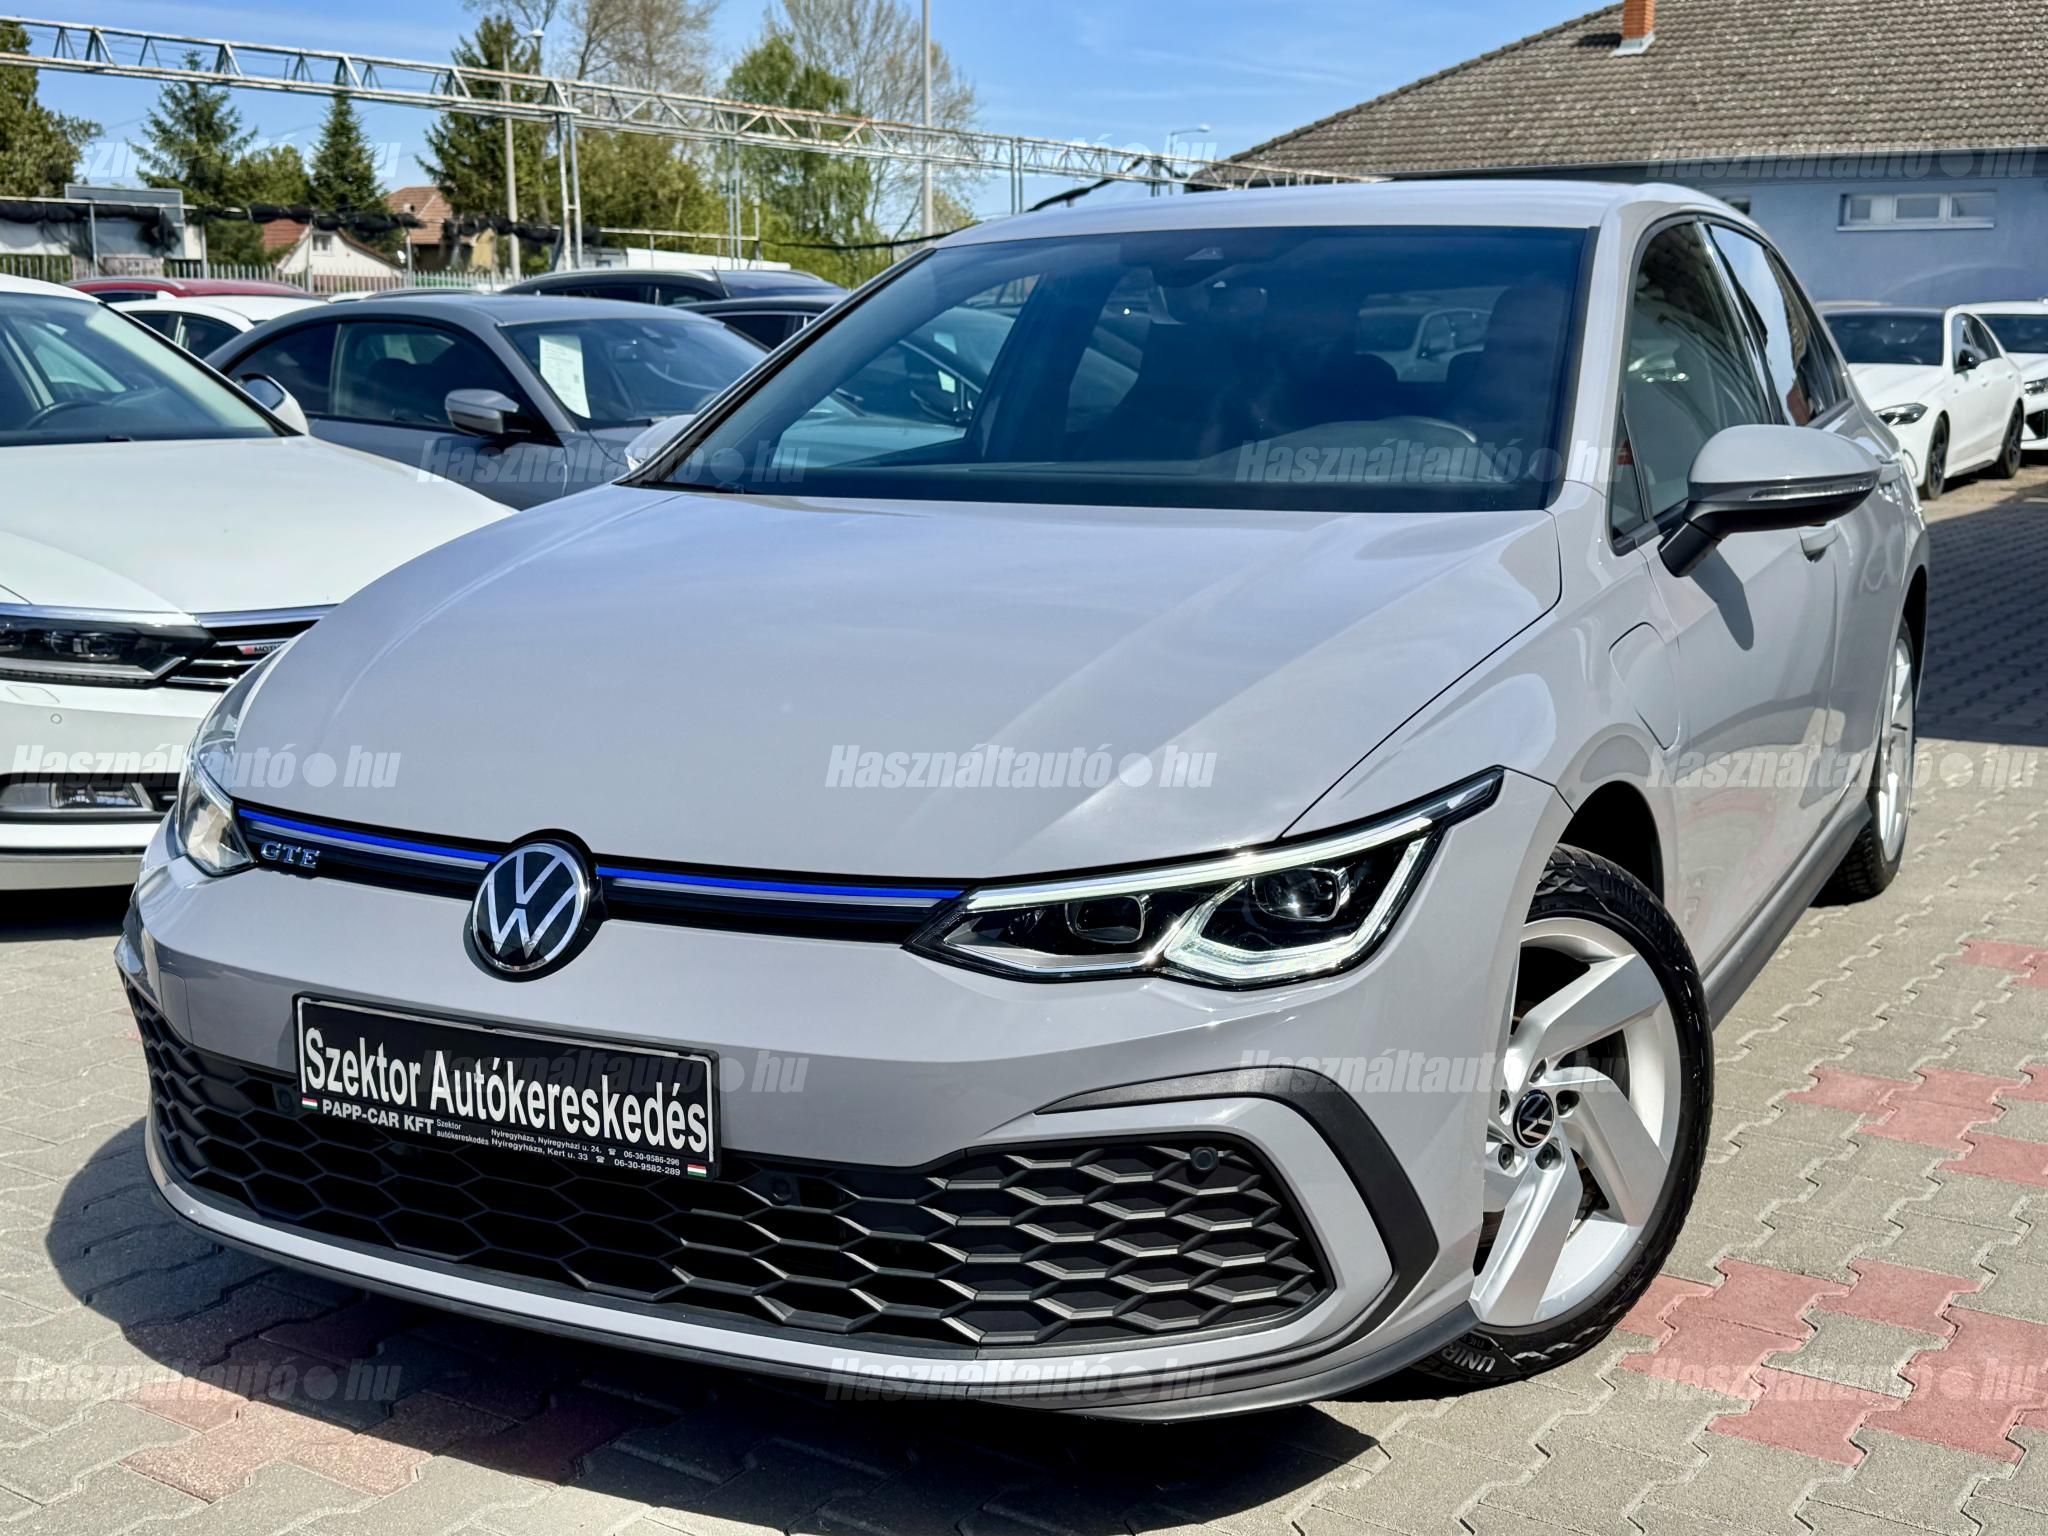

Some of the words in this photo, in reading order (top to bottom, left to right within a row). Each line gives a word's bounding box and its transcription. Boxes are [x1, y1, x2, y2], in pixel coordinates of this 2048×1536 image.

[261, 841, 321, 869] GTE
[305, 1027, 421, 1107] Szektor
[430, 1050, 707, 1153] Autókereskedés
[322, 1099, 400, 1128] PAPP-CAR
[404, 1114, 435, 1134] KFT
[436, 1119, 462, 1130] Szektor
[547, 1147, 566, 1158] Kert
[578, 1152, 589, 1161] 33
